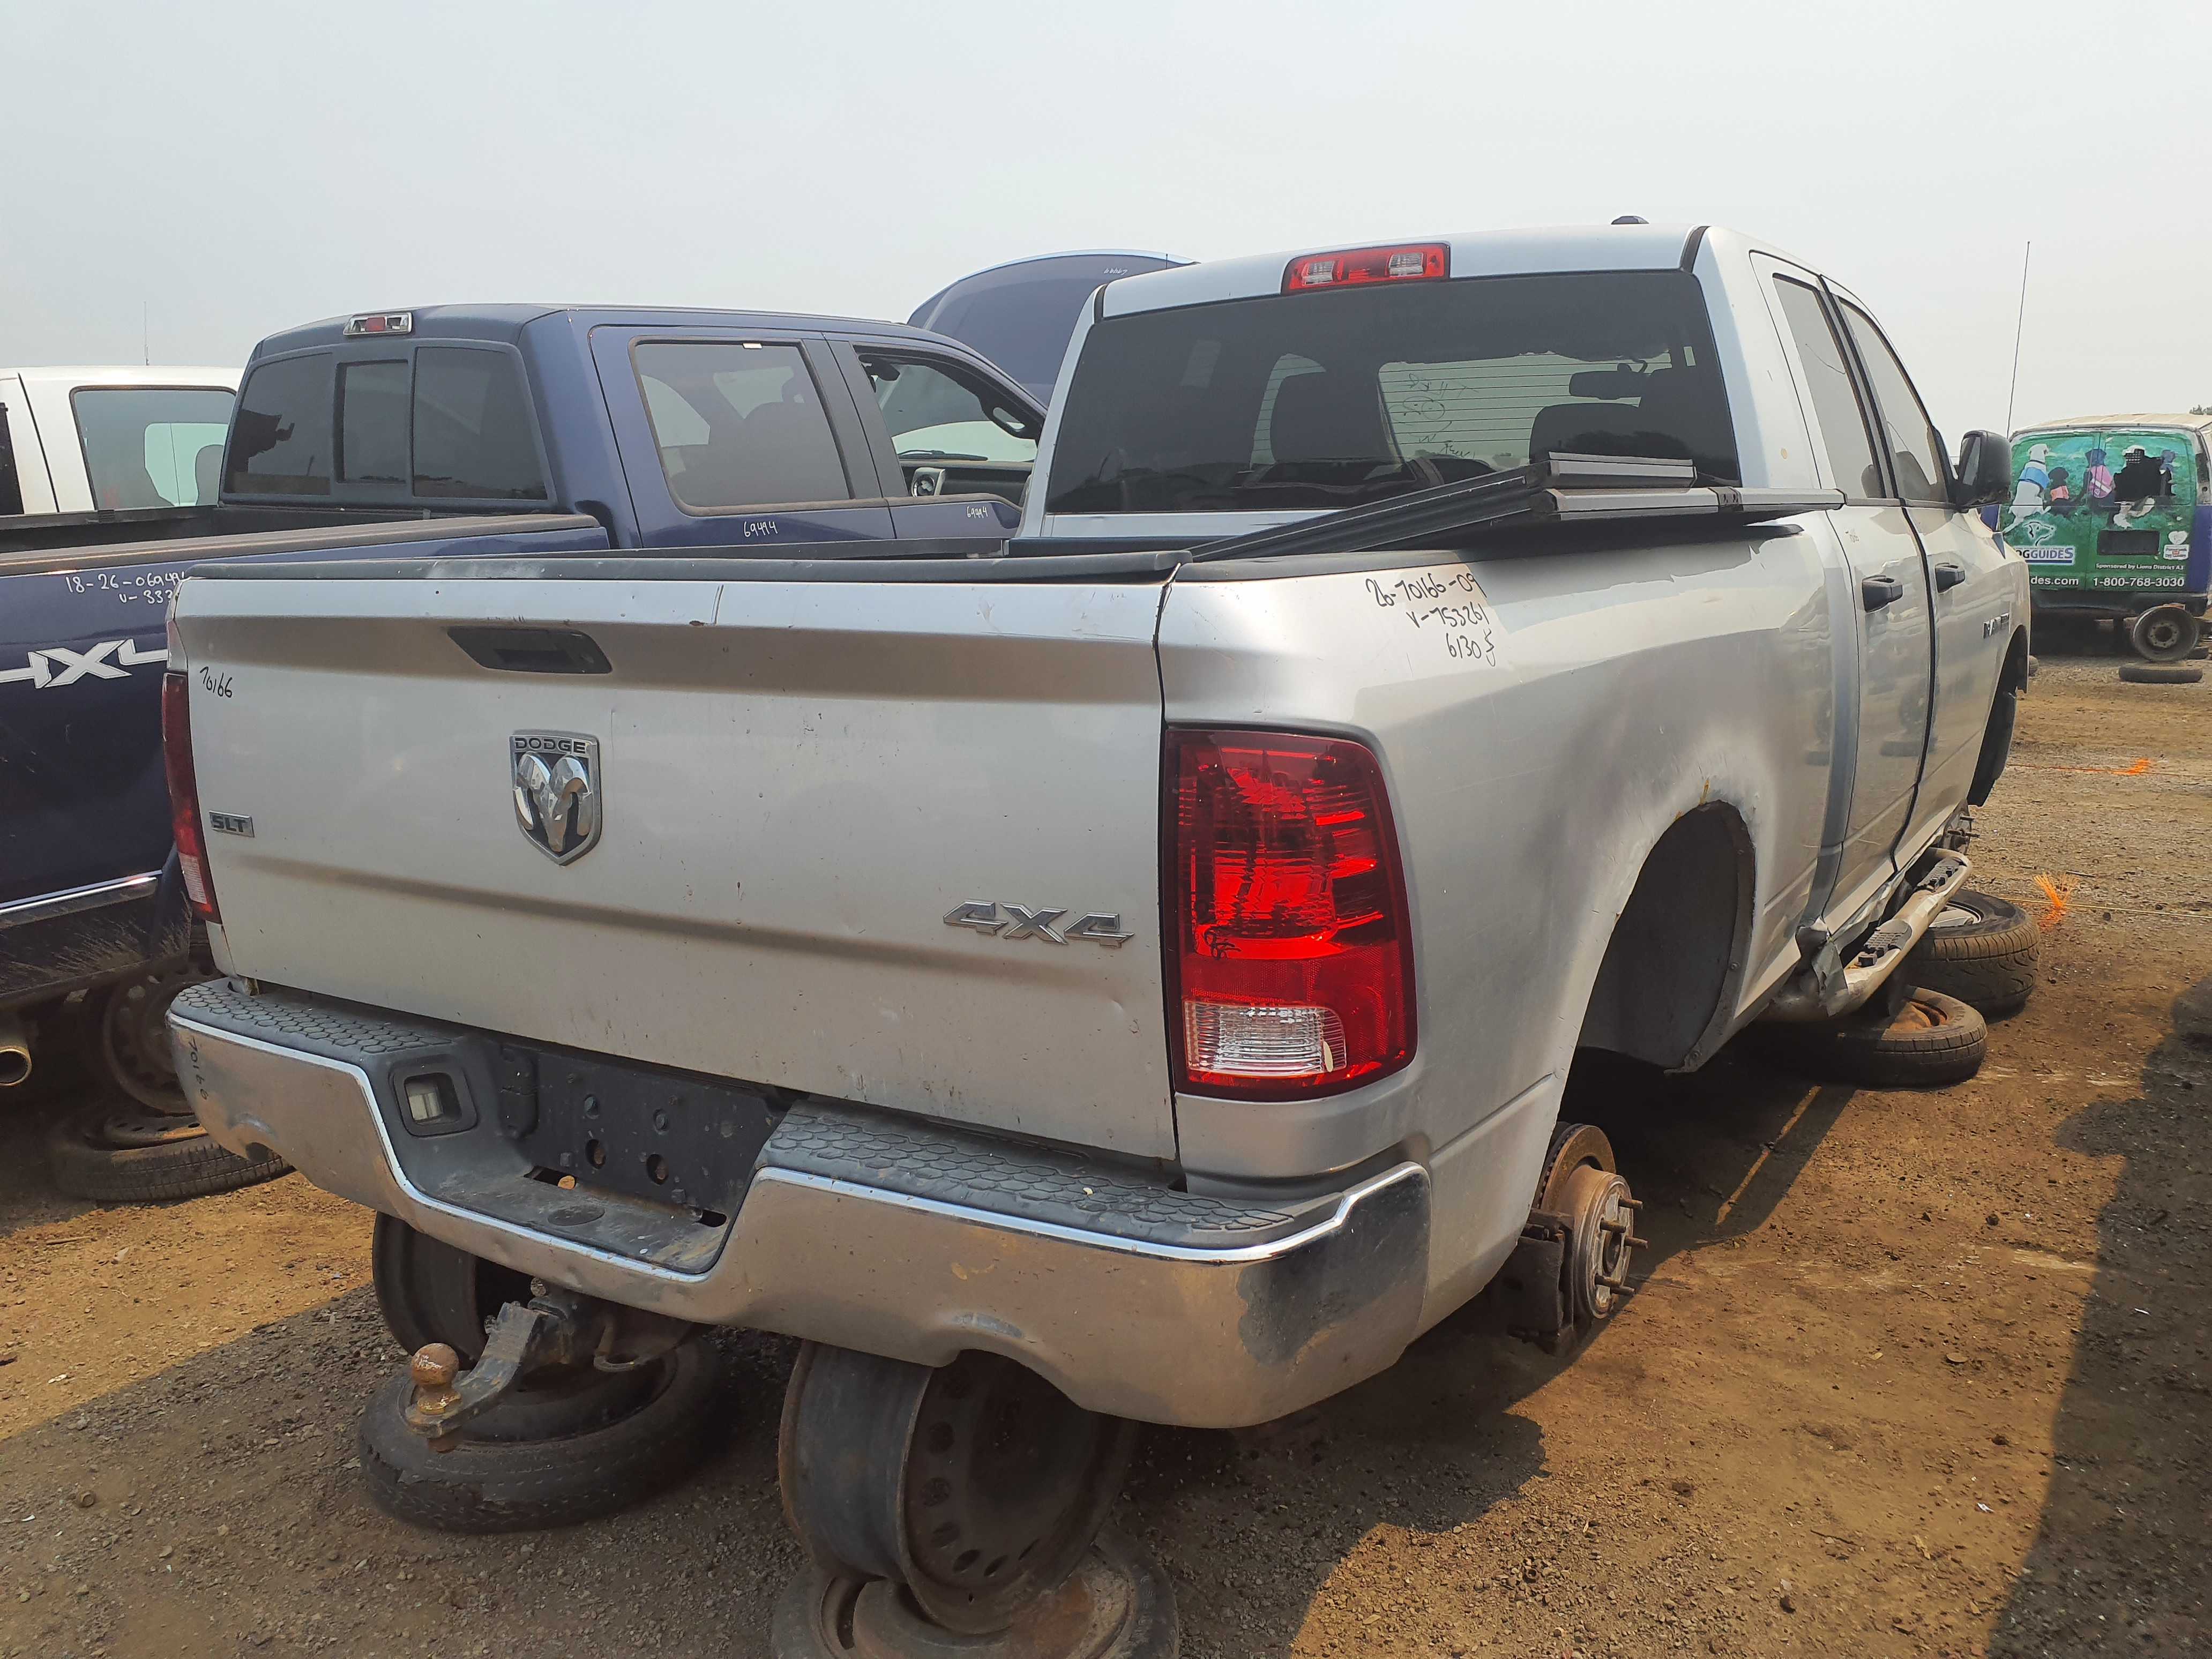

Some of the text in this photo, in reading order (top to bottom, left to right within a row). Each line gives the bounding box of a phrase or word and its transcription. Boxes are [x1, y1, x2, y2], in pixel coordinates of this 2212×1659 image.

[744, 521, 778, 537] 69494
[2093, 577, 2185, 587] 1-800-768-3030
[199, 666, 233, 698] 70166
[515, 737, 586, 754] DODGE
[211, 816, 247, 833] SLT
